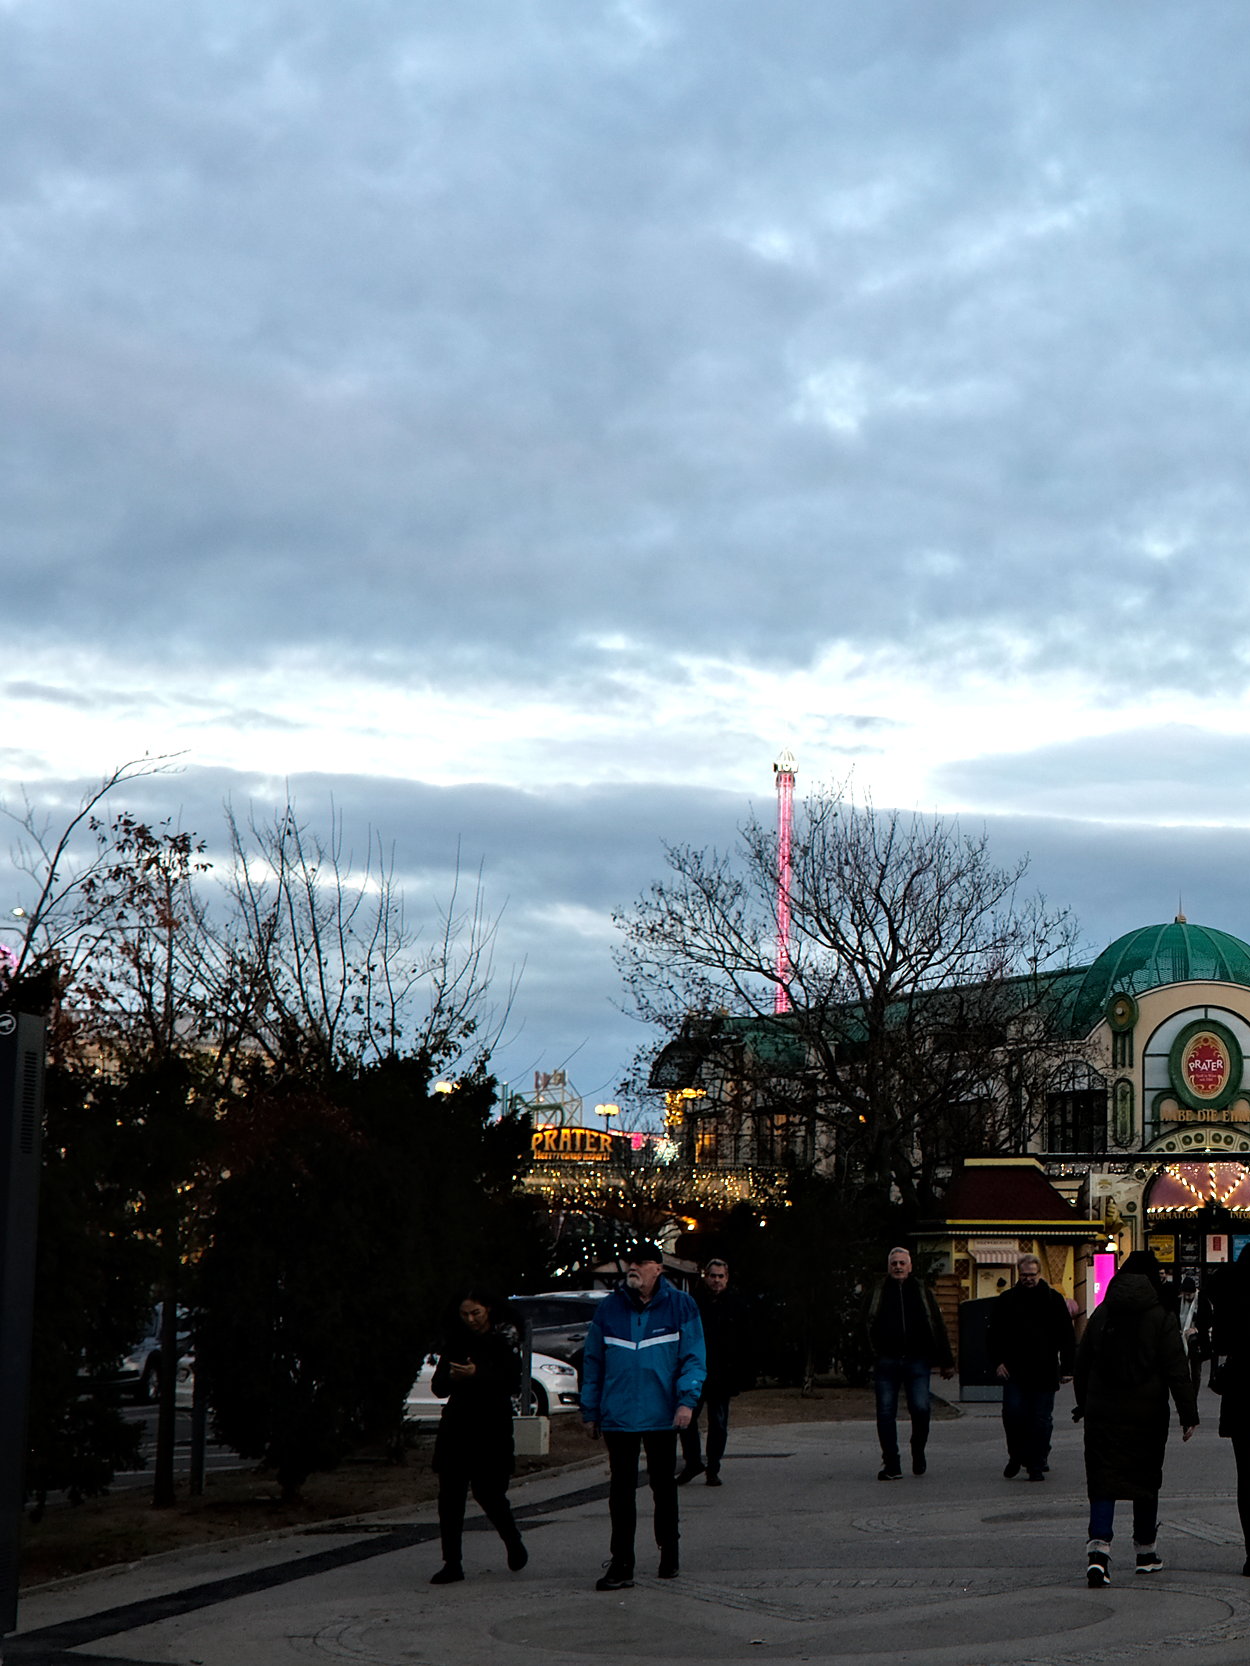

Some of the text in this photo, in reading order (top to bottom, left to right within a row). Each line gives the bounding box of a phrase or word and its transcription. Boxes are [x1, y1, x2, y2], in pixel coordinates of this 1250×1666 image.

[1189, 1060, 1223, 1072] PRATER
[1197, 1109, 1218, 1122] DIE
[531, 1128, 613, 1152] PRATER
